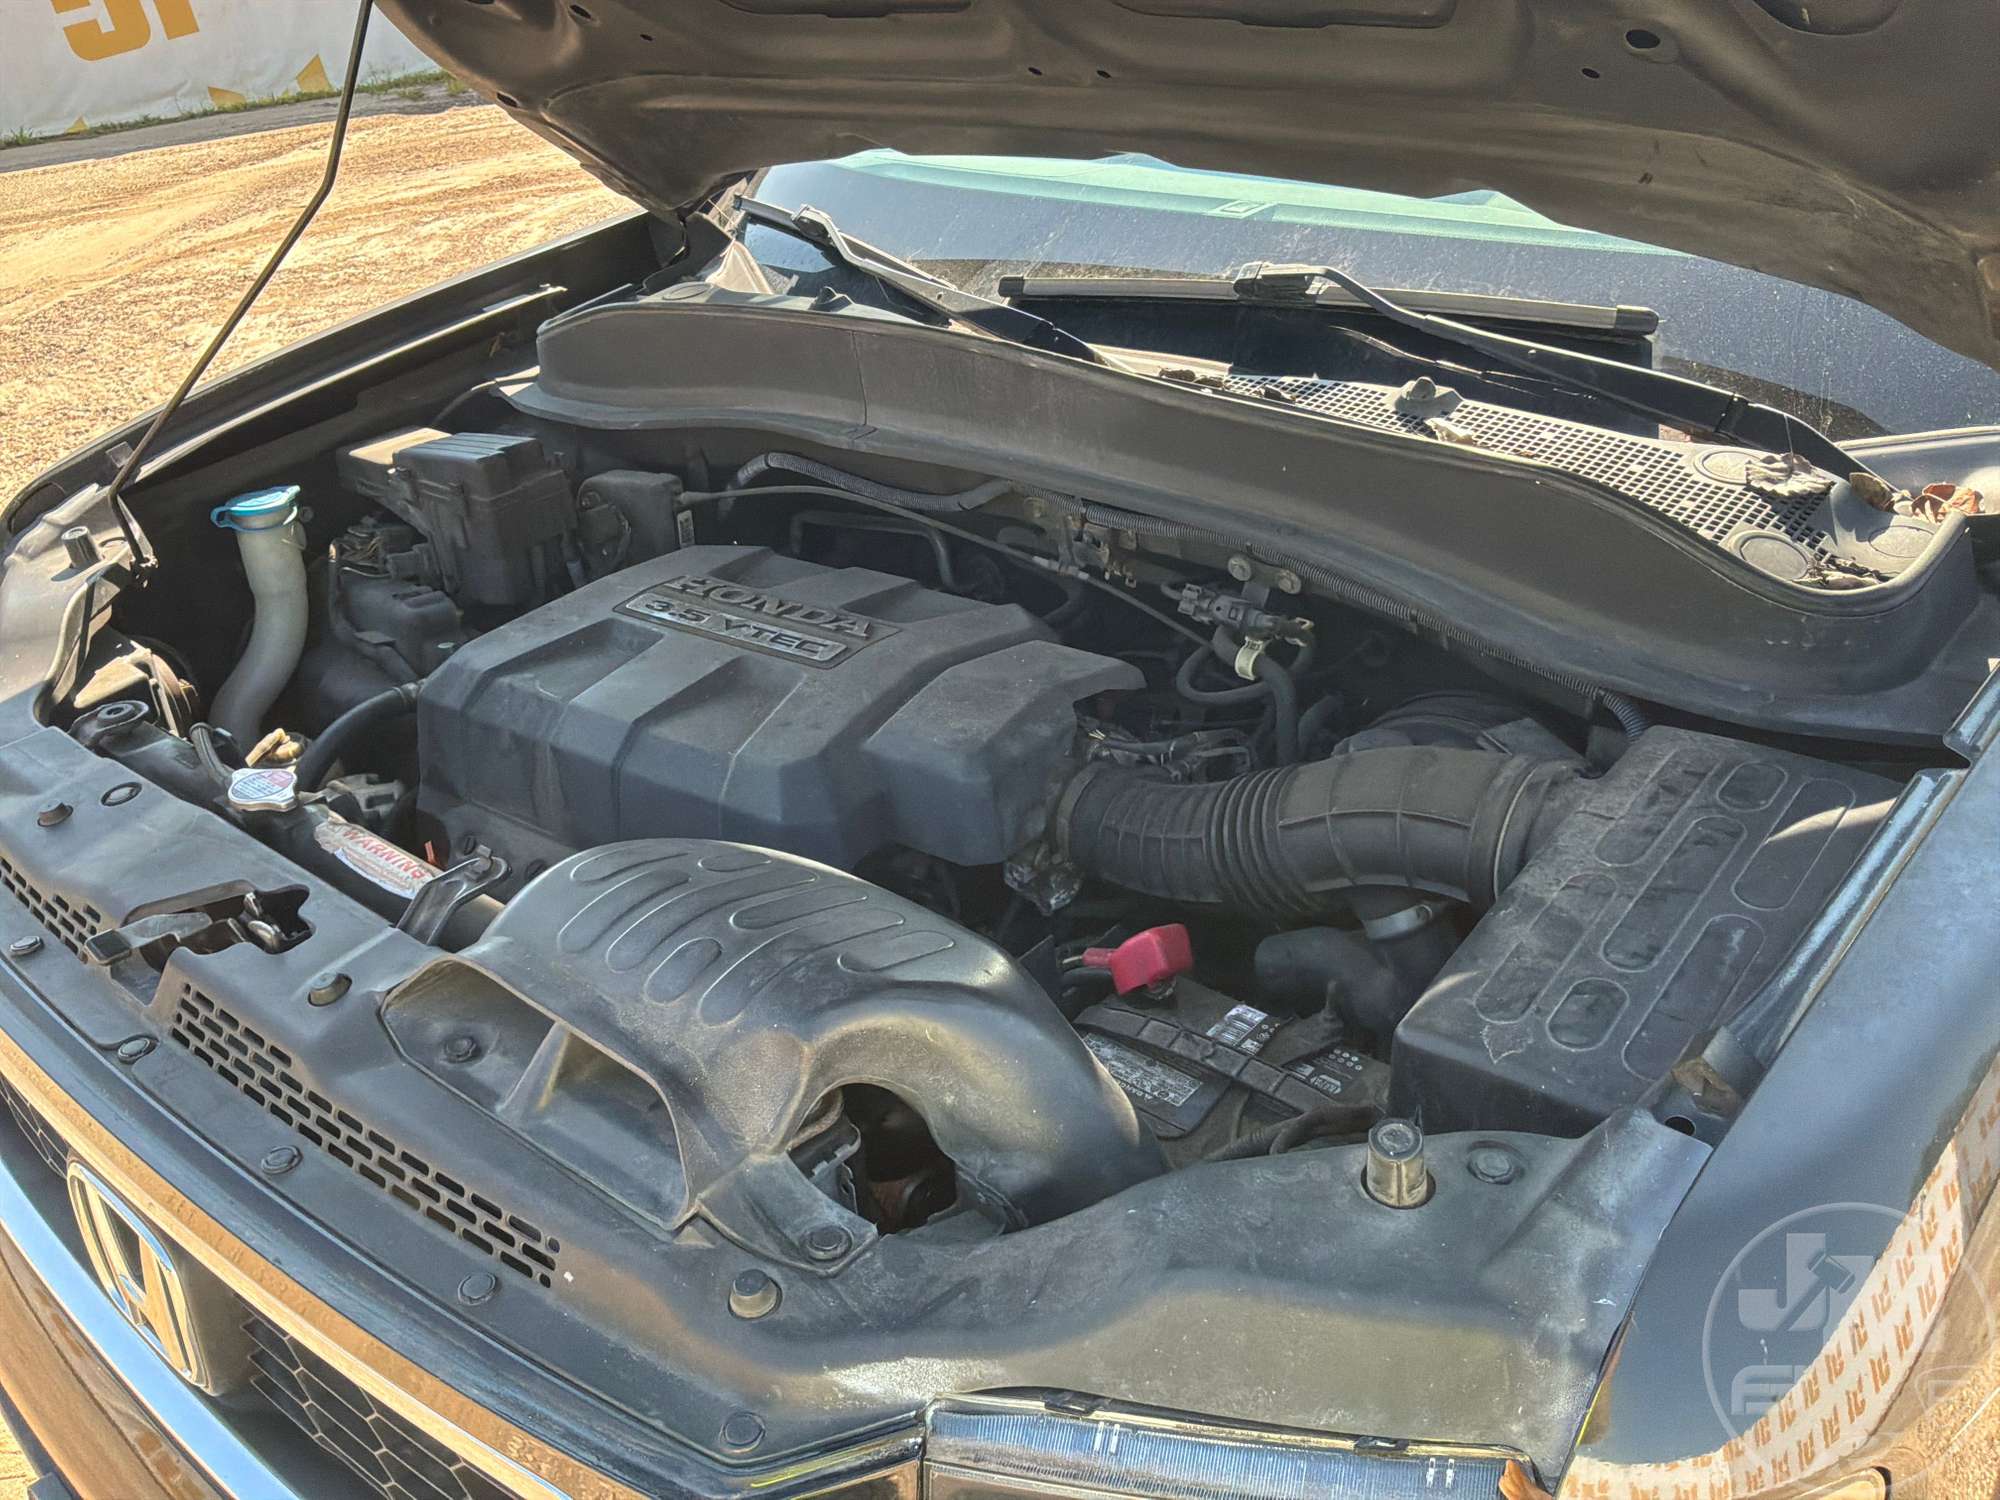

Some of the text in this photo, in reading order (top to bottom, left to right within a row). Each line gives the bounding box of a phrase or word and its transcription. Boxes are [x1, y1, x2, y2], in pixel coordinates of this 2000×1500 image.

[645, 599, 829, 656] 3.5 VTEC
[664, 575, 872, 639] HONDA
[342, 830, 427, 880] WARNING
